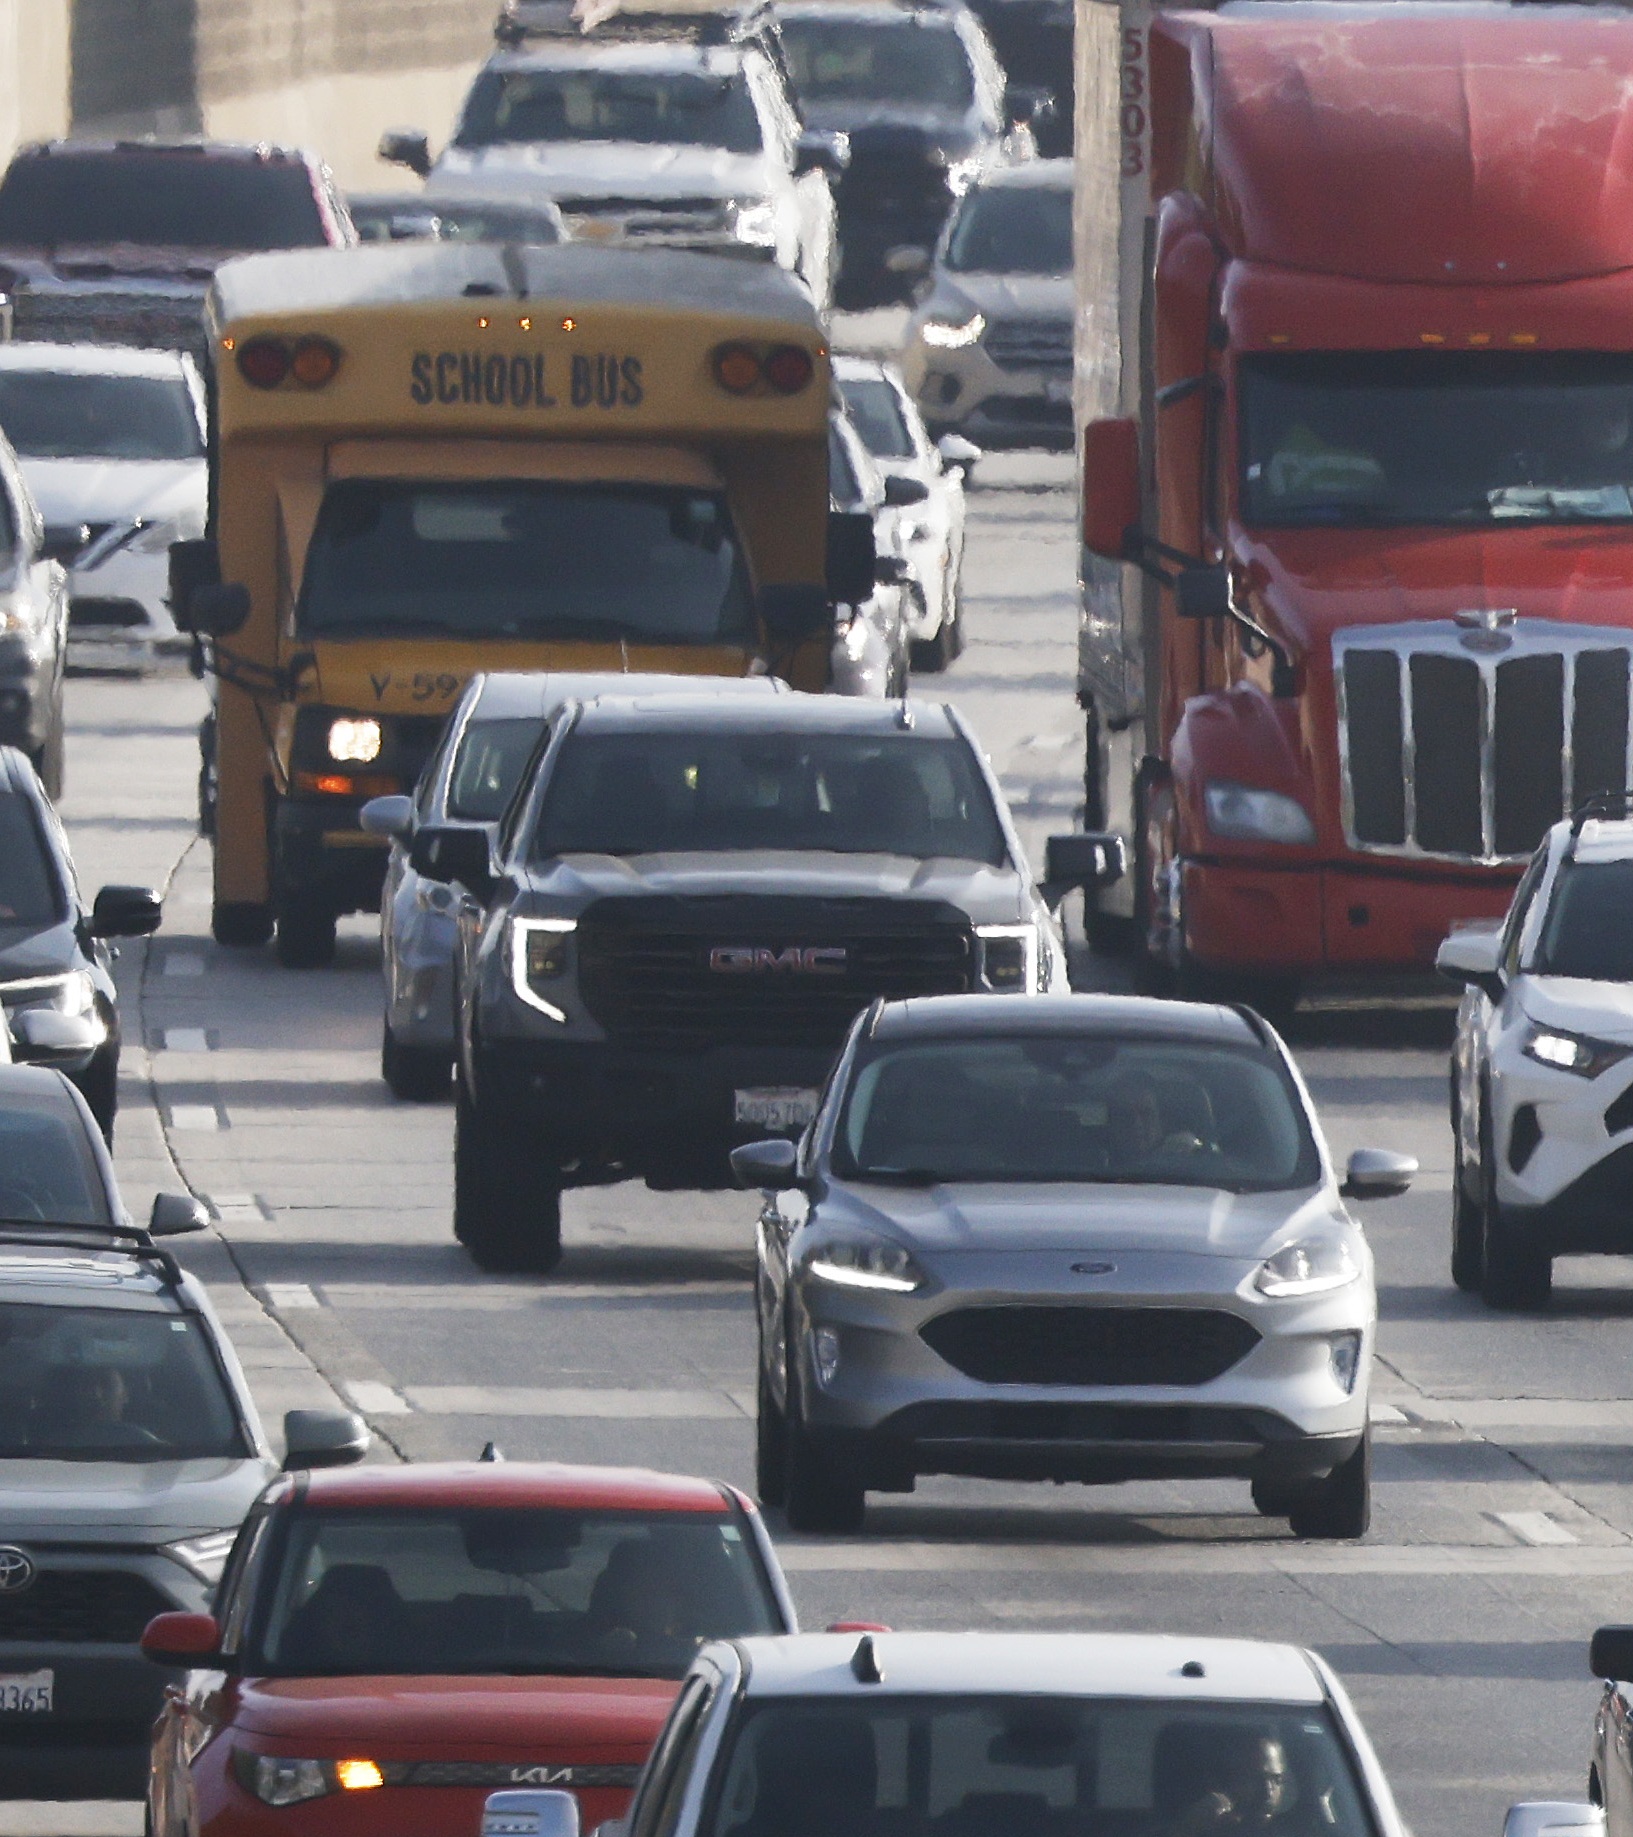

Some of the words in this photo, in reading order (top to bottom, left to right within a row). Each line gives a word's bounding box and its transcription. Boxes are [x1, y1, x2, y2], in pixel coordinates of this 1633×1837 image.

[1121, 27, 1145, 178] 5303
[411, 352, 558, 408] SCHOOL
[571, 352, 644, 409] BUS
[710, 948, 847, 974] GMC
[511, 1767, 573, 1783] KIA
